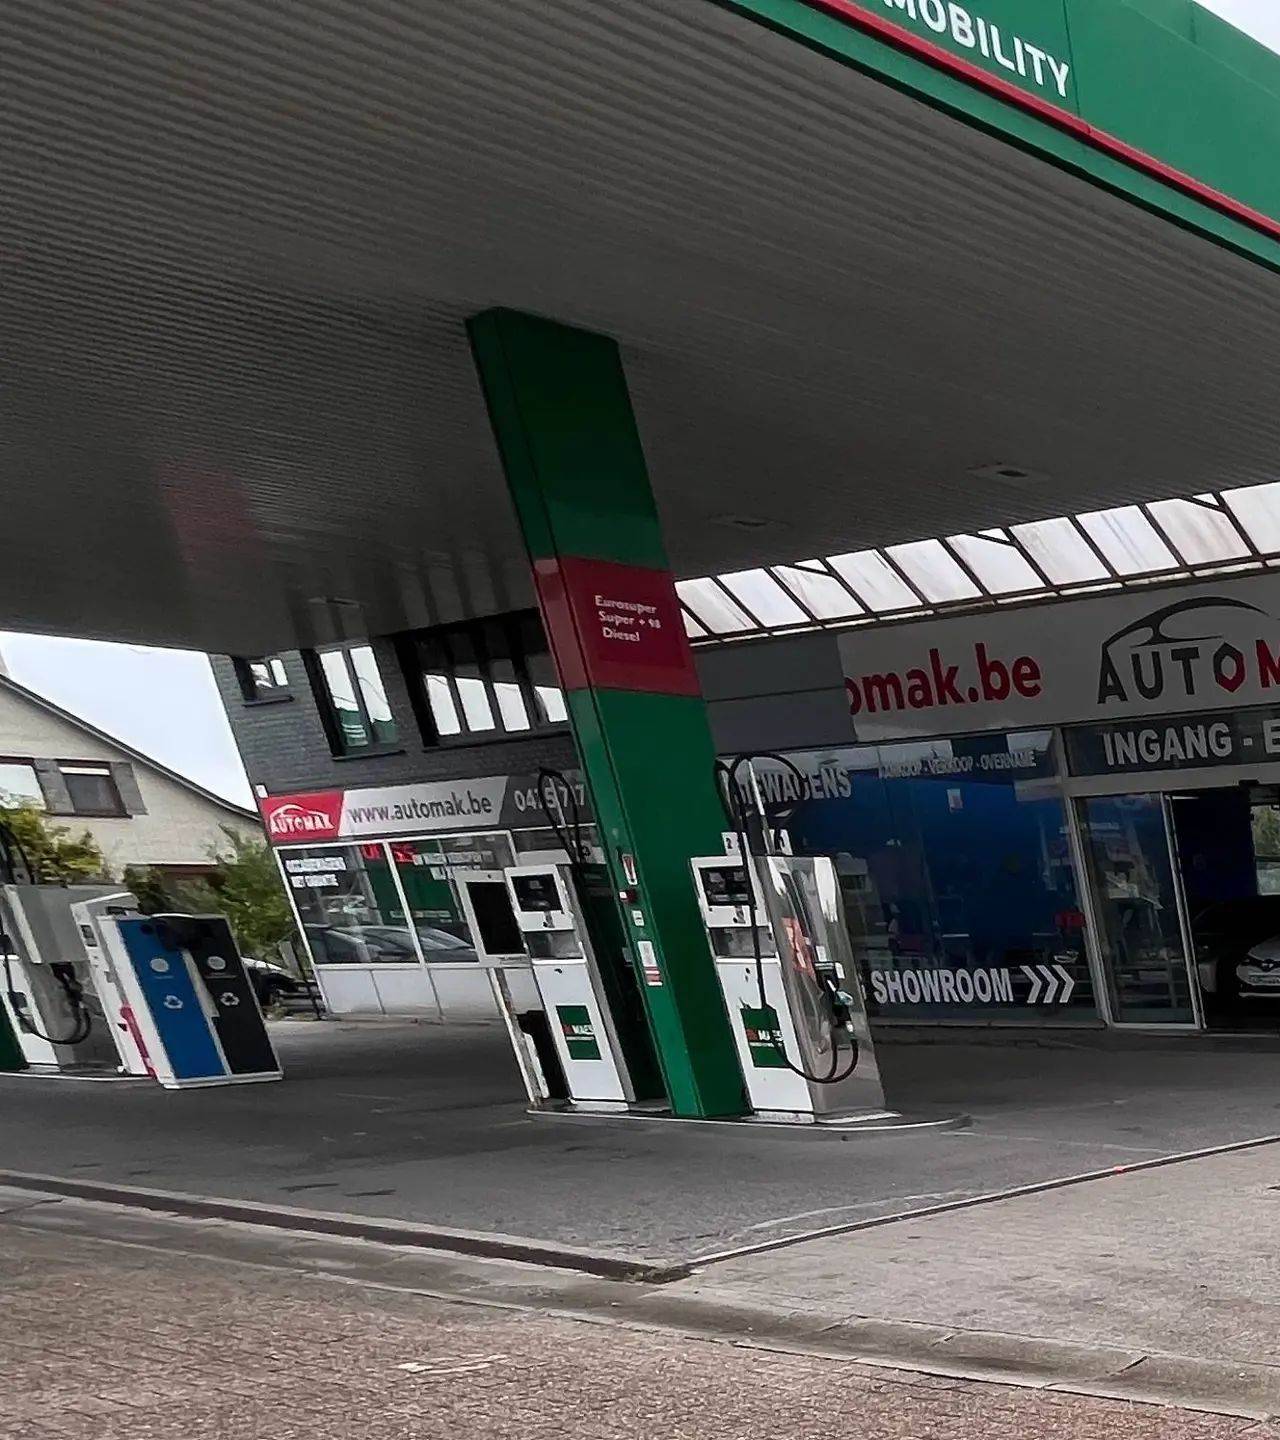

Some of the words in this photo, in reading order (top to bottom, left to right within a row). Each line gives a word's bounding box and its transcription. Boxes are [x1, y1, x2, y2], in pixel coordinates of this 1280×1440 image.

[595, 595, 657, 615] Eurosuper
[599, 611, 634, 626] Super
[602, 627, 640, 641] Diesel
[1103, 721, 1234, 766] INGANG
[980, 750, 1037, 771] OVERNAME
[348, 789, 493, 824] www.automak.be
[270, 812, 335, 836] AUTOMAK
[870, 968, 1014, 1004] SHOWROOM
